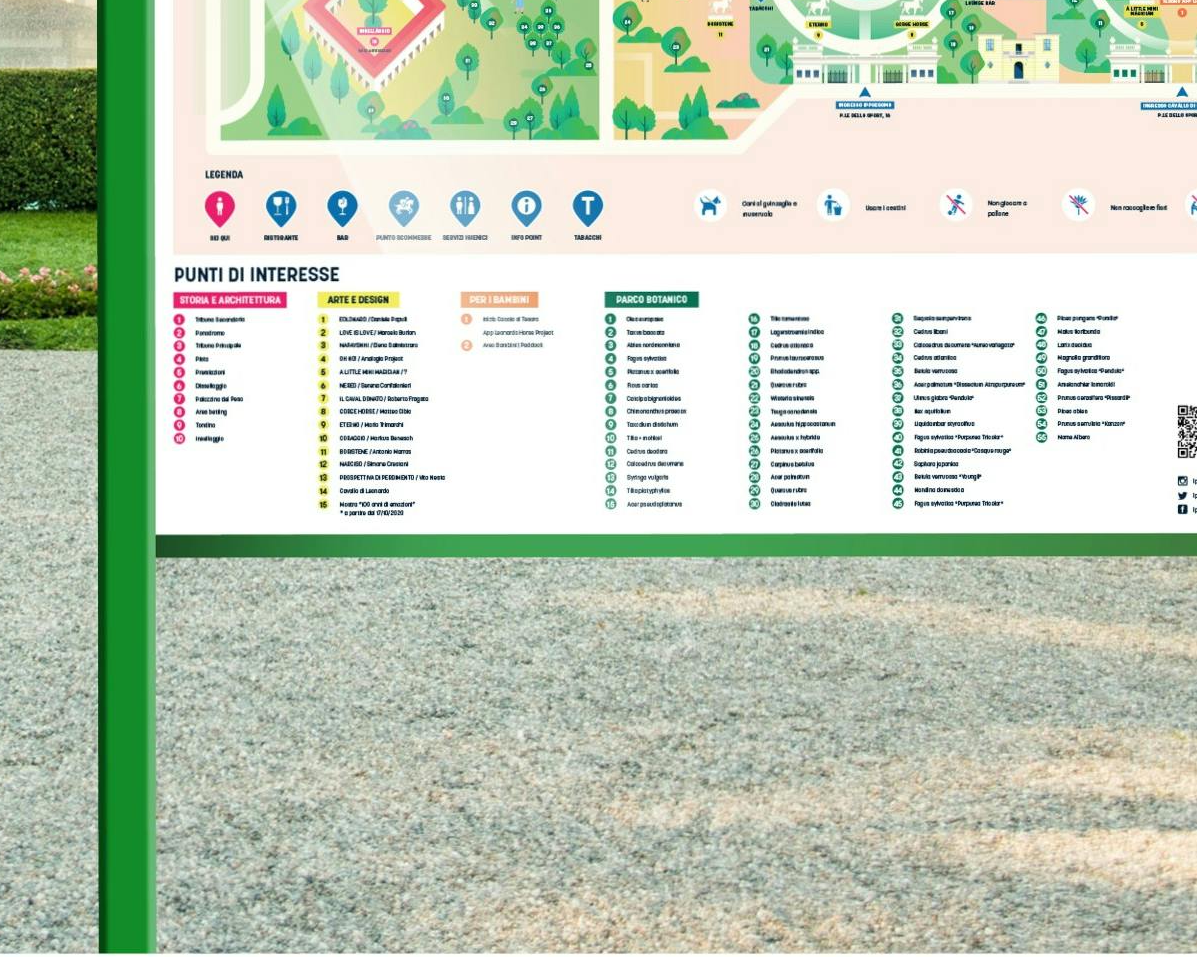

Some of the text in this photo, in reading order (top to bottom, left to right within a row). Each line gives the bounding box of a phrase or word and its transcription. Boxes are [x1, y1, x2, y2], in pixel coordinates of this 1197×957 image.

[205, 170, 243, 179] LEGENDA
[175, 267, 339, 282] PUNTI DI INTERESSE
[180, 296, 210, 304] STORIA
[219, 296, 281, 304] ARCHITETTURA
[328, 296, 349, 304] ARTE
[358, 296, 389, 304] DESIGN
[469, 296, 487, 304] PER
[494, 296, 529, 304] BAMBINI
[616, 295, 687, 303] PARCO BOTANICO
